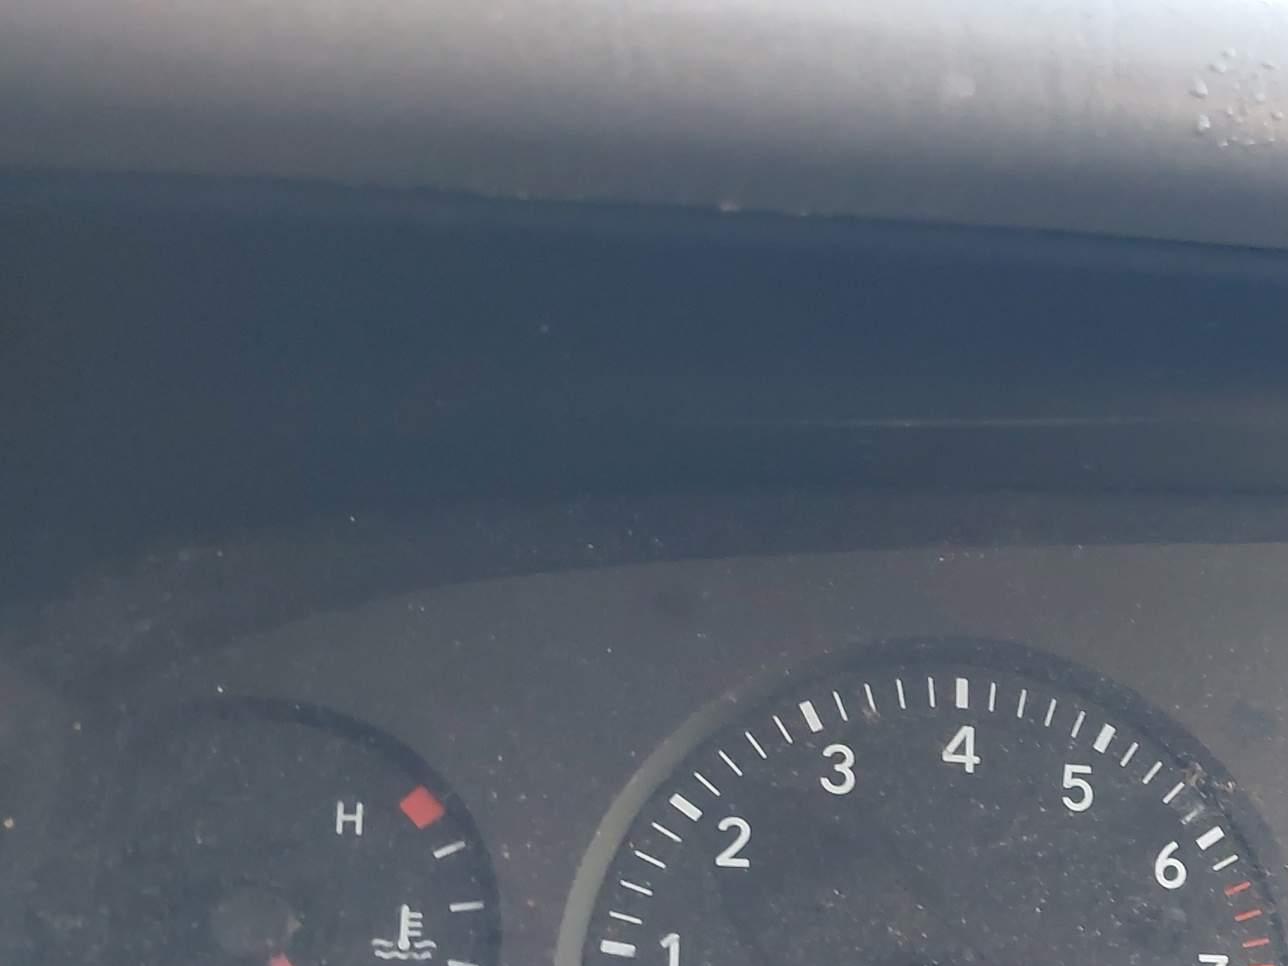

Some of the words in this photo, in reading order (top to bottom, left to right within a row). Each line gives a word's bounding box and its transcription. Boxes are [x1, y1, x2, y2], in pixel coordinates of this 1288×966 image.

[820, 744, 856, 795] 3
[942, 726, 981, 773] 4
[1062, 764, 1094, 813] 5
[336, 801, 363, 836] H
[715, 816, 751, 869] 2
[1154, 842, 1187, 889] 6
